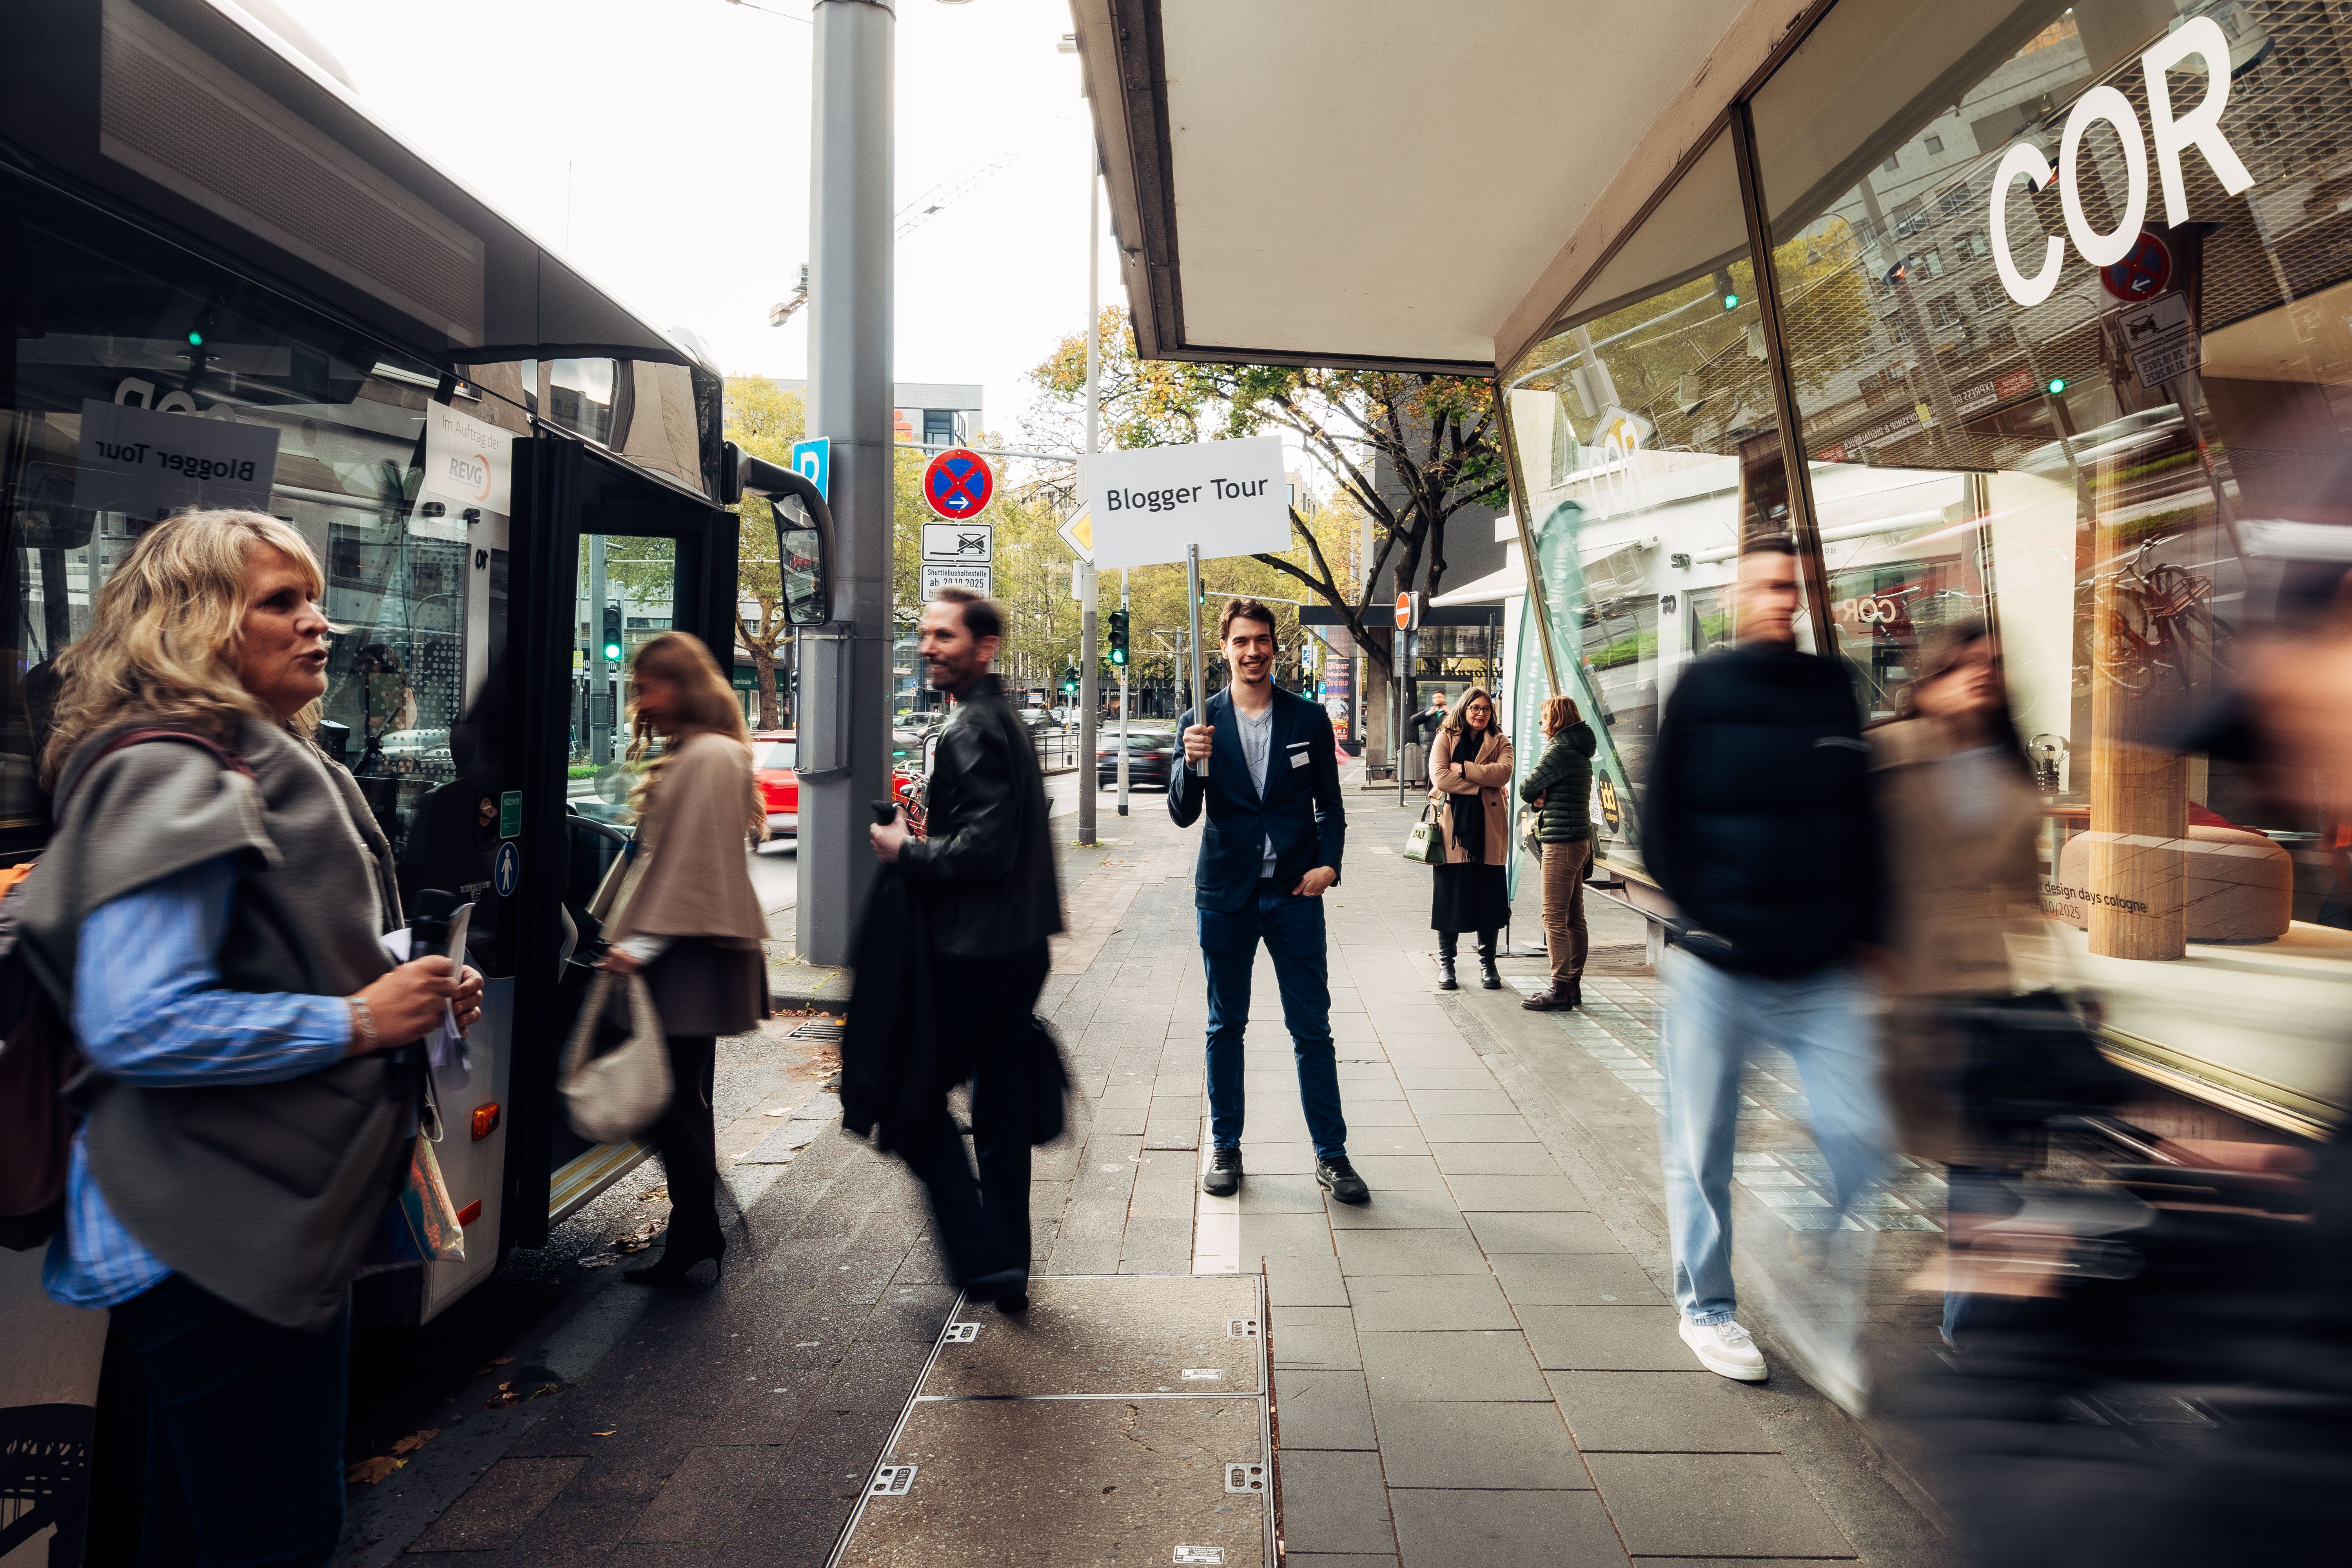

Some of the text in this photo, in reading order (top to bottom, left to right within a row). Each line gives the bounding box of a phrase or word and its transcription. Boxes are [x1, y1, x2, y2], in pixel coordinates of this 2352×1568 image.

[1989, 16, 2256, 306] COR
[442, 414, 500, 450] Im Auftrag der
[450, 457, 482, 484] REVG
[801, 451, 819, 484] P
[1107, 478, 1269, 513] Blogger Tour
[927, 569, 987, 577] Shuttlebushaltestelle
[930, 578, 939, 587] ab
[1320, 684, 1325, 693] P
[1600, 781, 1617, 811] idd
[2045, 881, 2076, 900] design
[2078, 887, 2102, 905] days
[2103, 894, 2147, 914] cologne
[1234, 1472, 1243, 1486] B125
